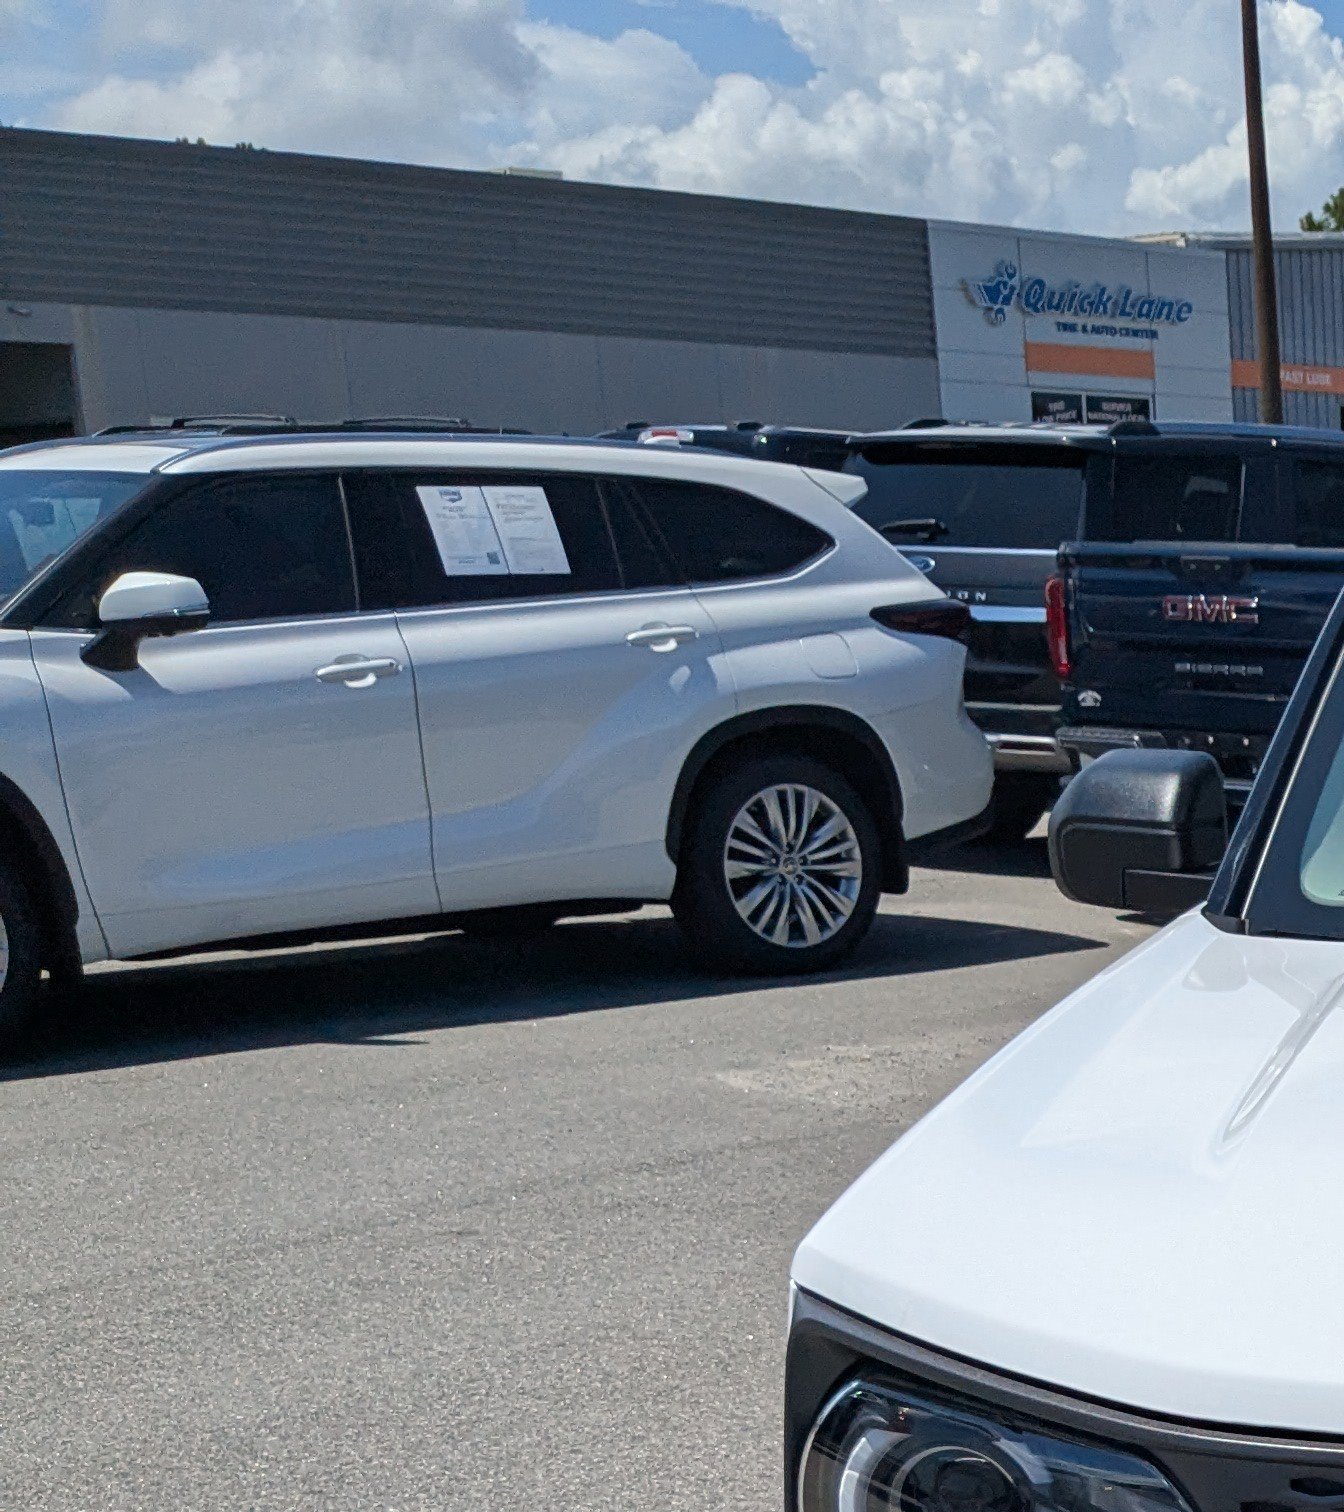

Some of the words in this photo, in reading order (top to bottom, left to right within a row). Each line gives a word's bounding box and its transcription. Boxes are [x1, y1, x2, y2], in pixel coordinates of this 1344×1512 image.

[1024, 278, 1113, 316] Quick
[1118, 288, 1194, 323] Lane
[1056, 321, 1078, 333] TIRE
[1090, 324, 1117, 337] AUTO
[1119, 327, 1158, 340] CENTER
[1163, 594, 1259, 624] GMC
